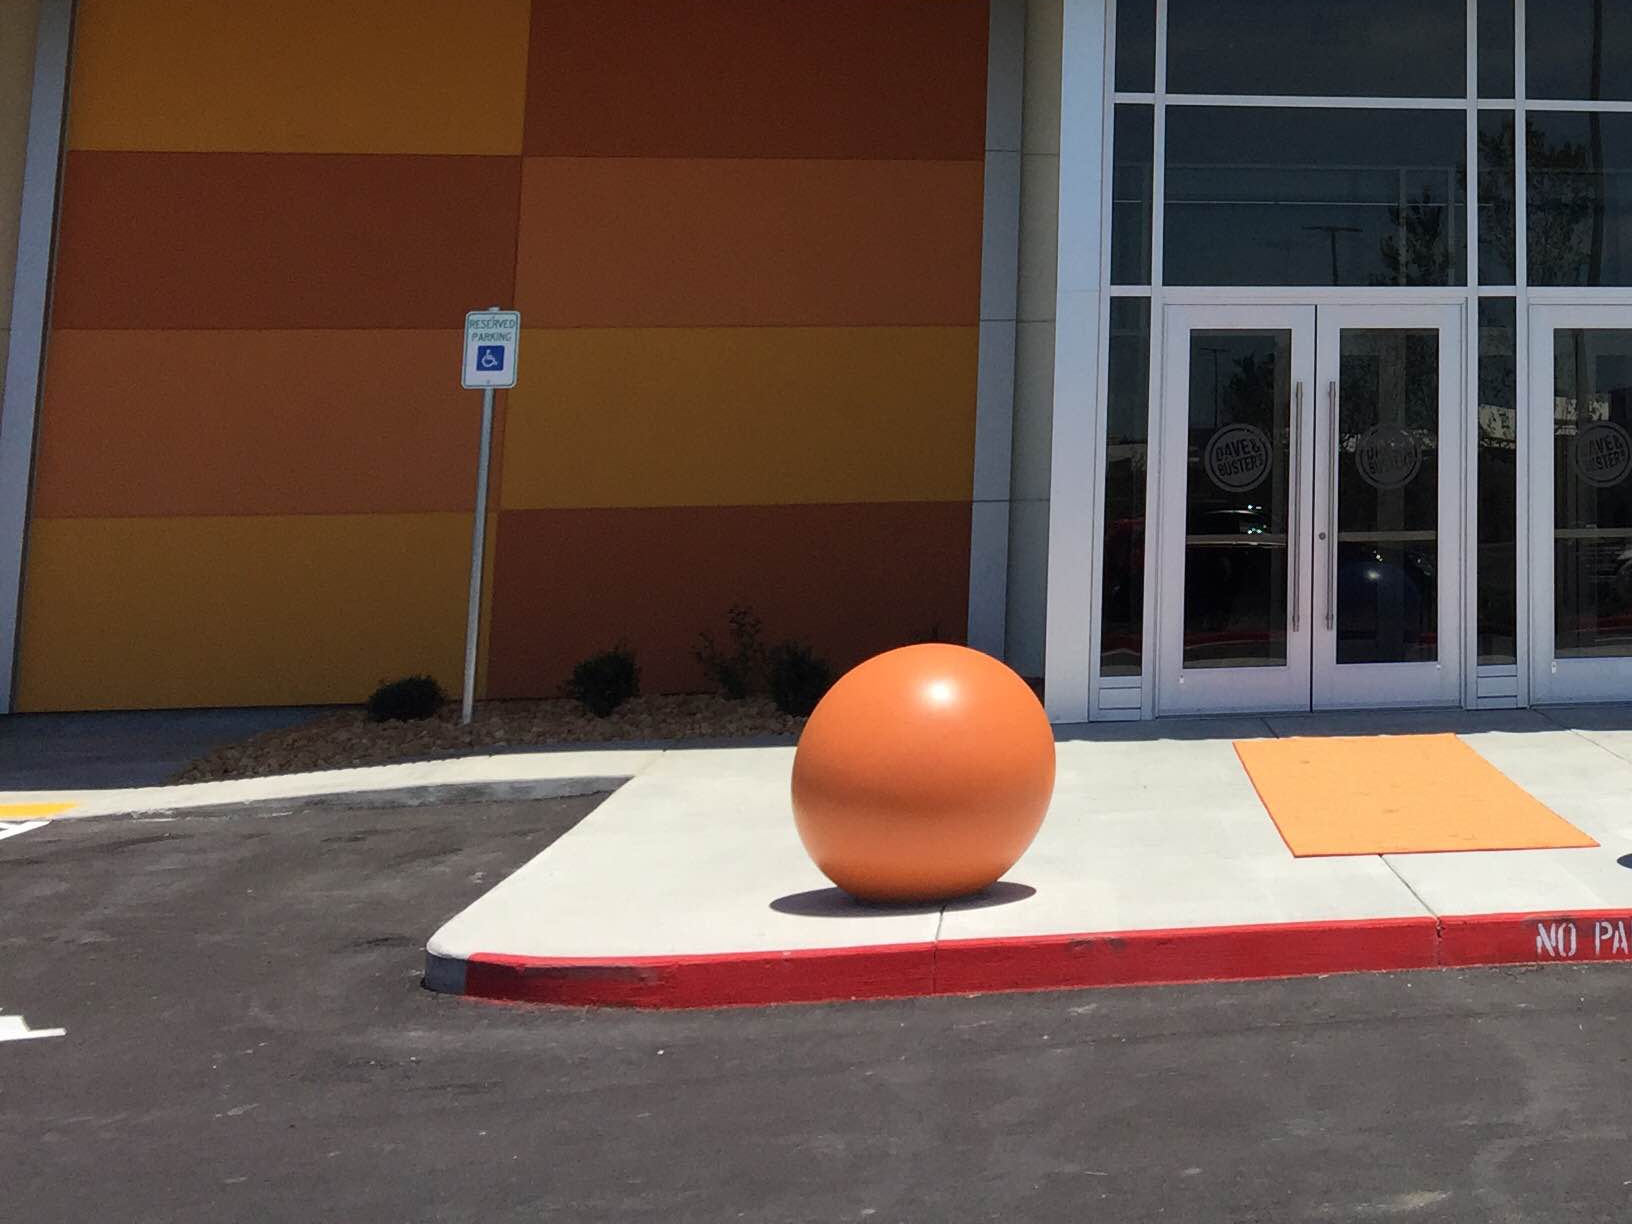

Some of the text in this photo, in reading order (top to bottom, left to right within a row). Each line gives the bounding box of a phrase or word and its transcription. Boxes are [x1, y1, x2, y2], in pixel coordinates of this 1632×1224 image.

[469, 319, 516, 329] RESERVED
[471, 332, 512, 342] PARKING
[1216, 439, 1251, 462] DAVE
[1536, 922, 1577, 957] NO
